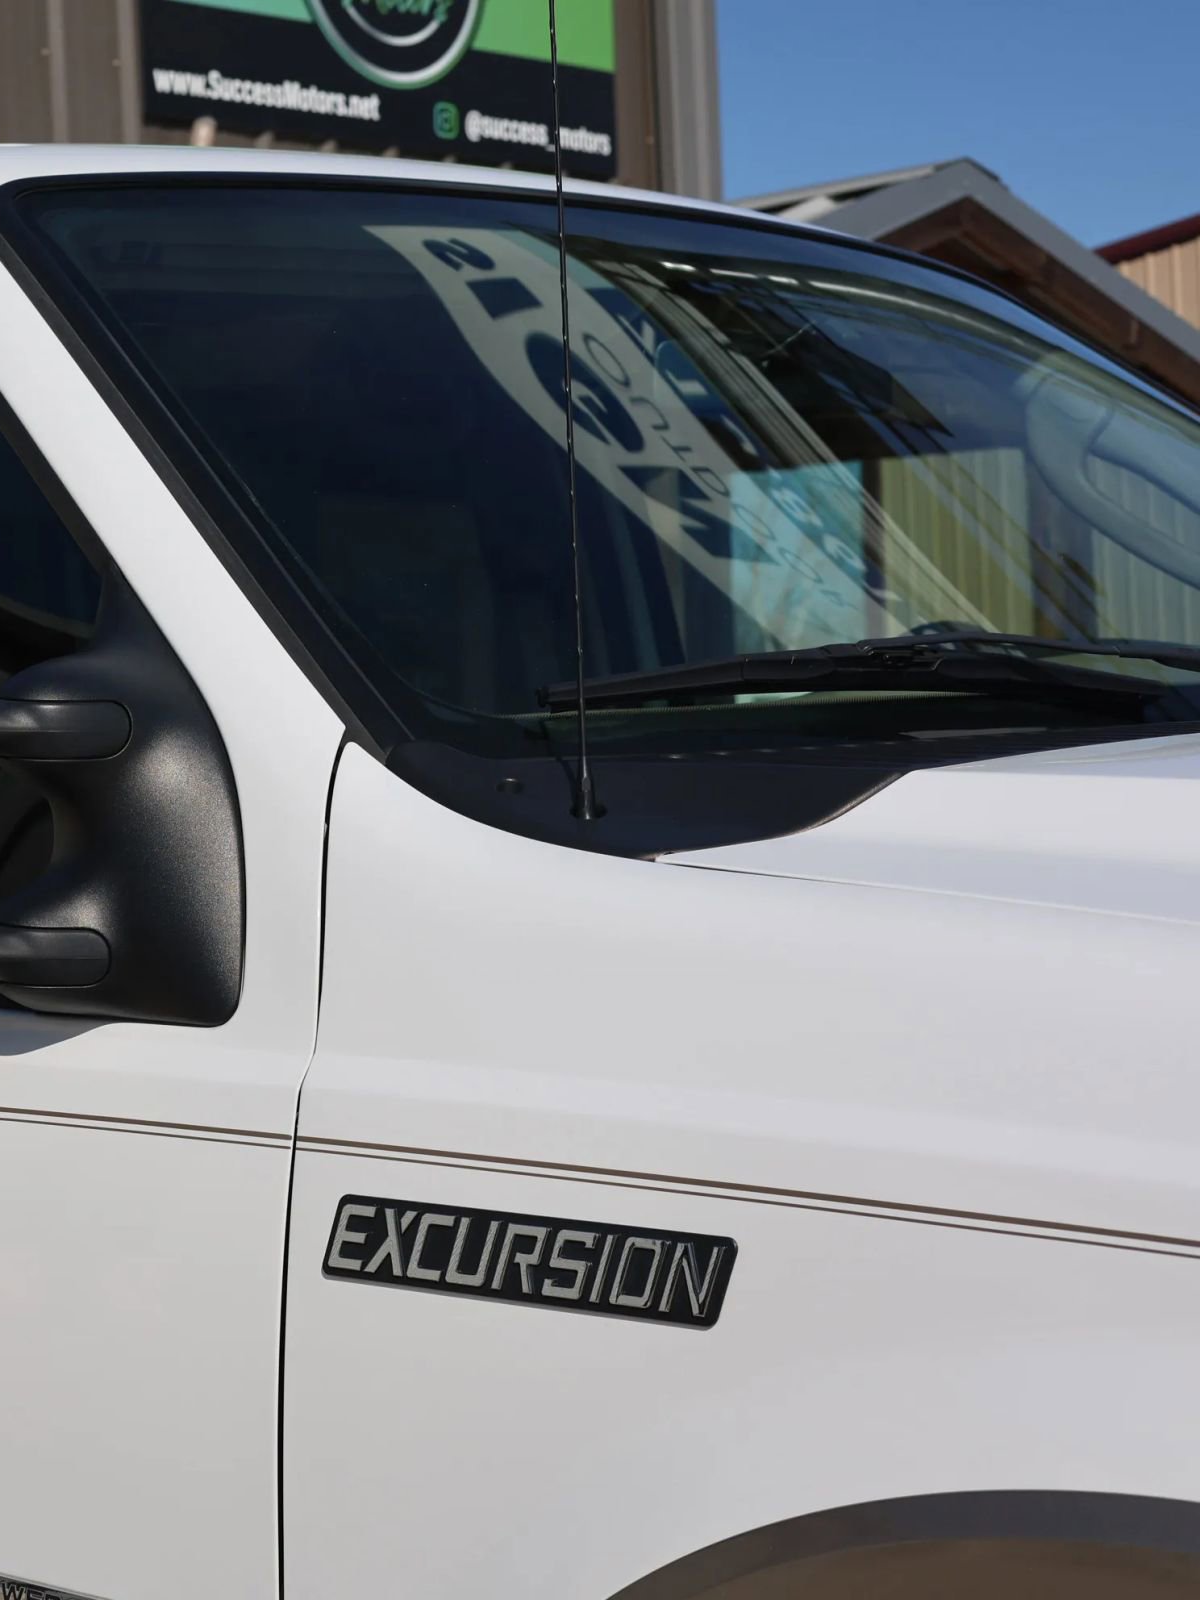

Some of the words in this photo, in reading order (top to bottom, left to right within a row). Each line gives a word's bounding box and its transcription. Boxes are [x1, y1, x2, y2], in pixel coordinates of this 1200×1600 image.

[152, 68, 381, 122] www.SuccessMotors.net
[464, 109, 612, 157] @success_motors
[327, 1202, 728, 1319] EXCURSION
